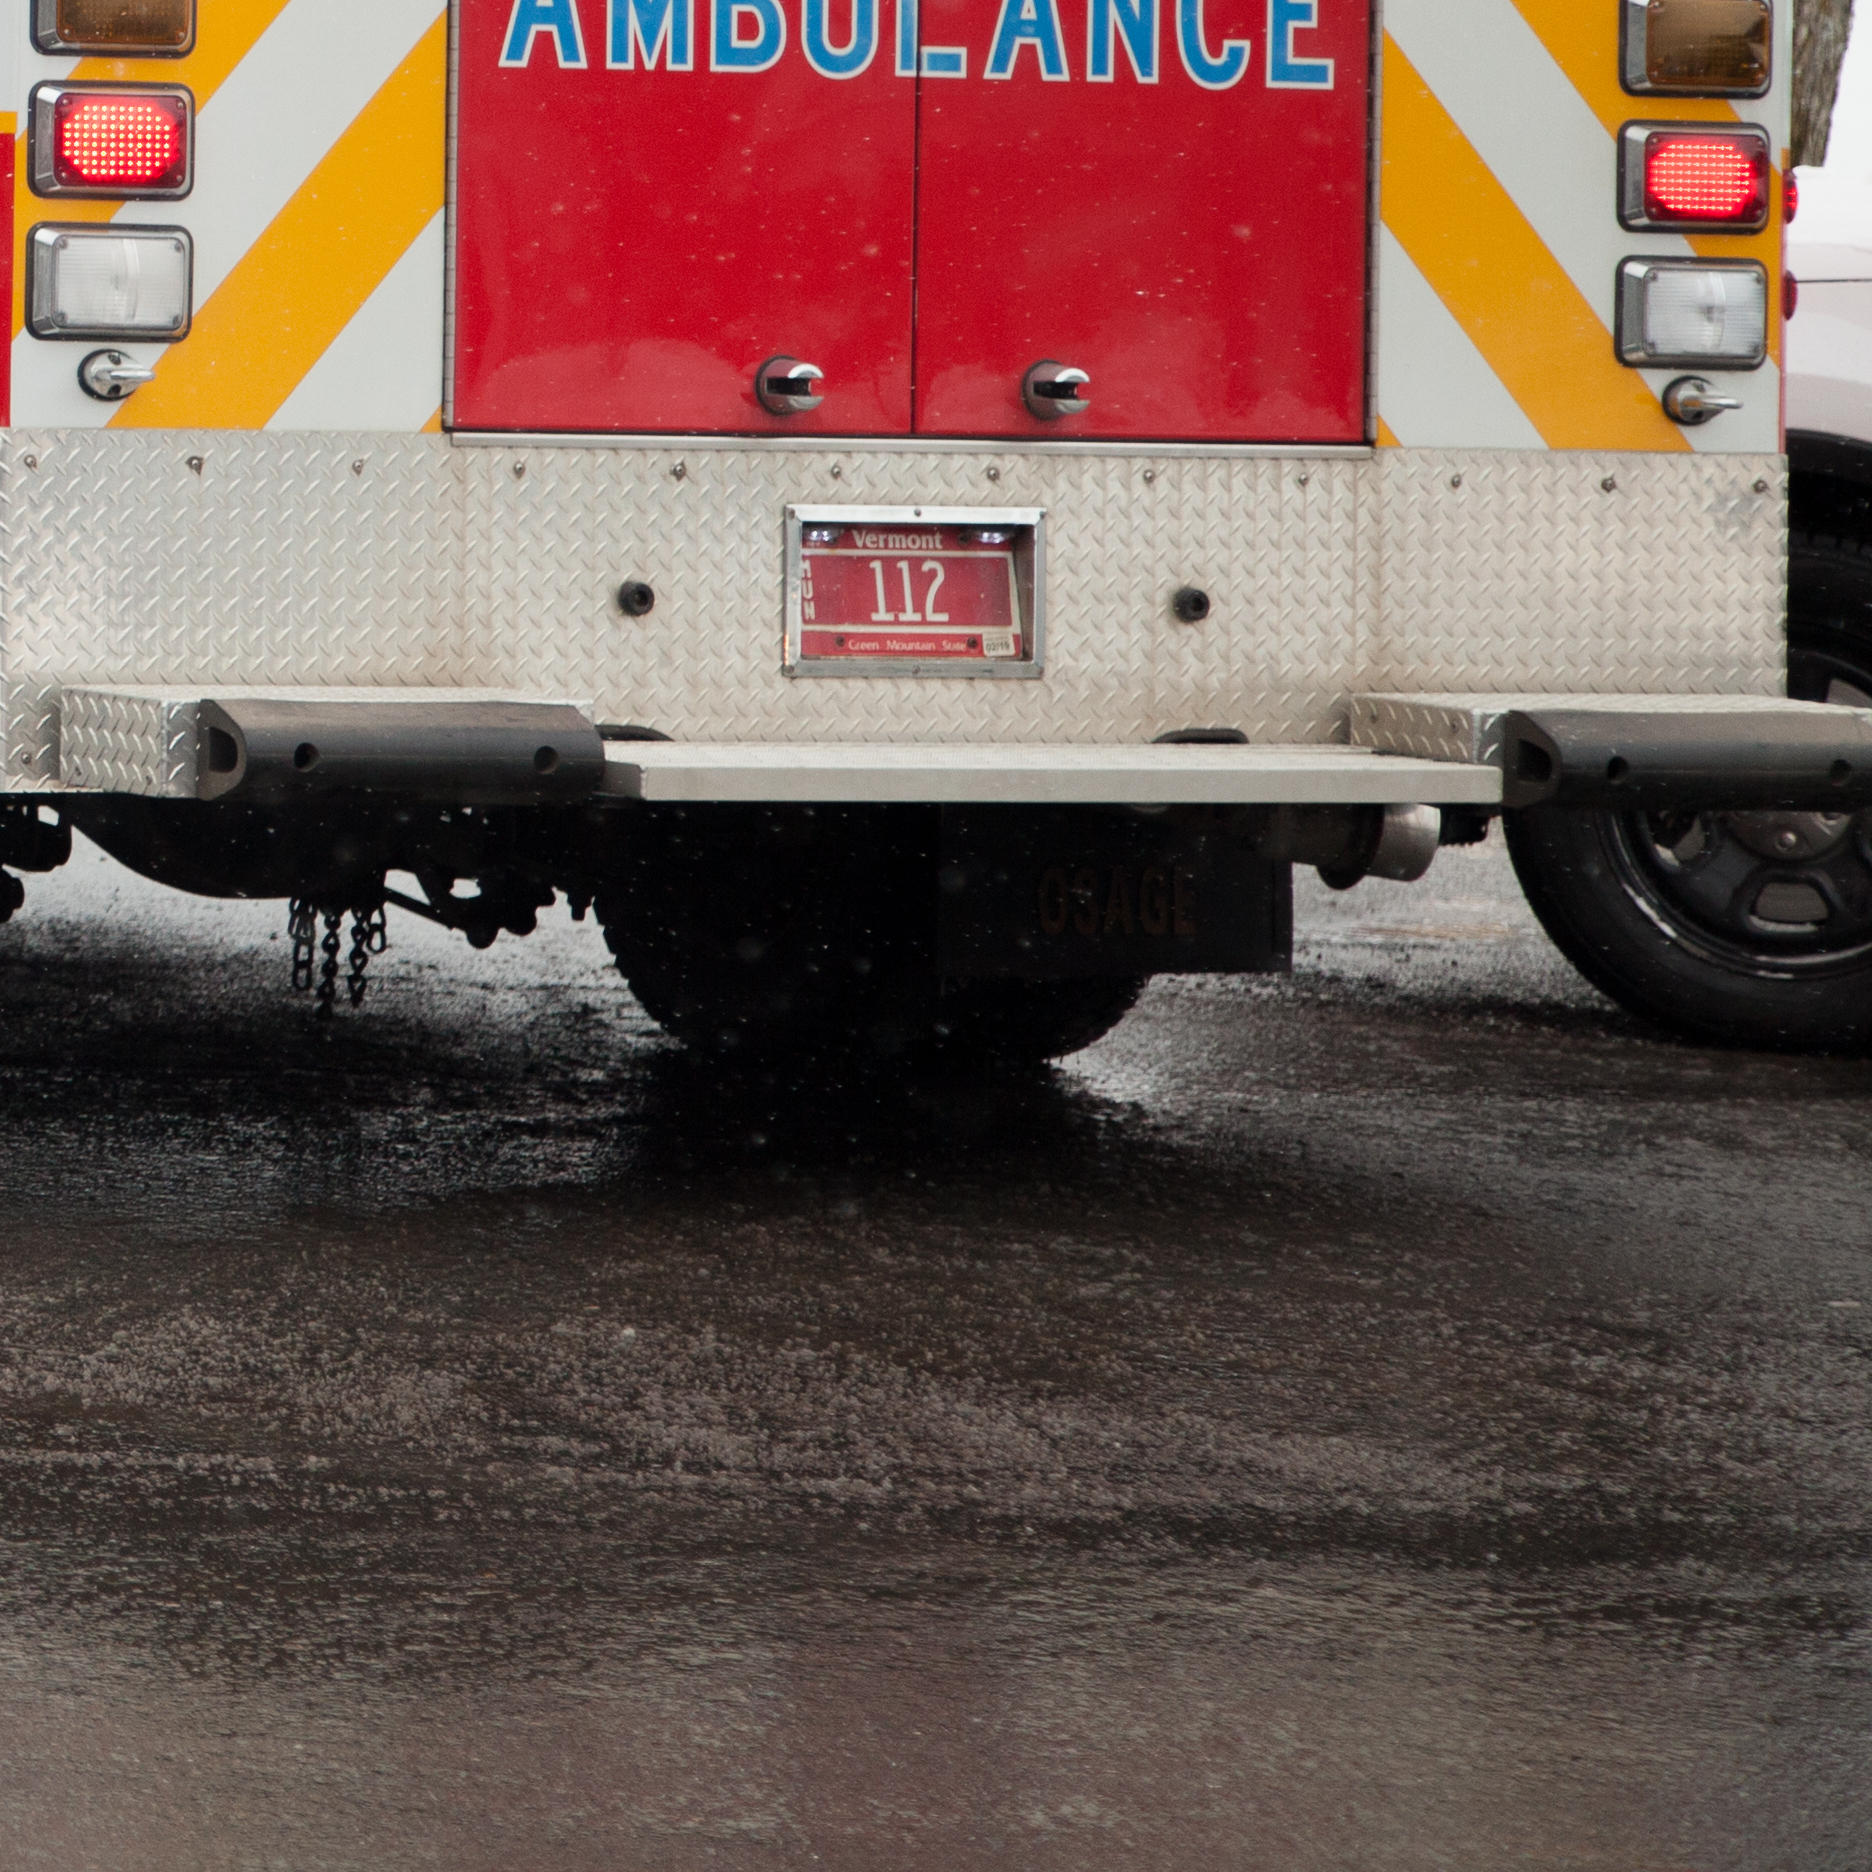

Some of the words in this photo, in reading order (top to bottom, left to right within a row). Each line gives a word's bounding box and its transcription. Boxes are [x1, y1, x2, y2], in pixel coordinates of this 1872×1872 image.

[852, 530, 943, 550] Vermont
[869, 559, 950, 622] 112
[848, 639, 880, 651] Green
[886, 639, 936, 651] Mountain
[941, 639, 967, 652] State
[1038, 865, 1197, 936] OSAGE
